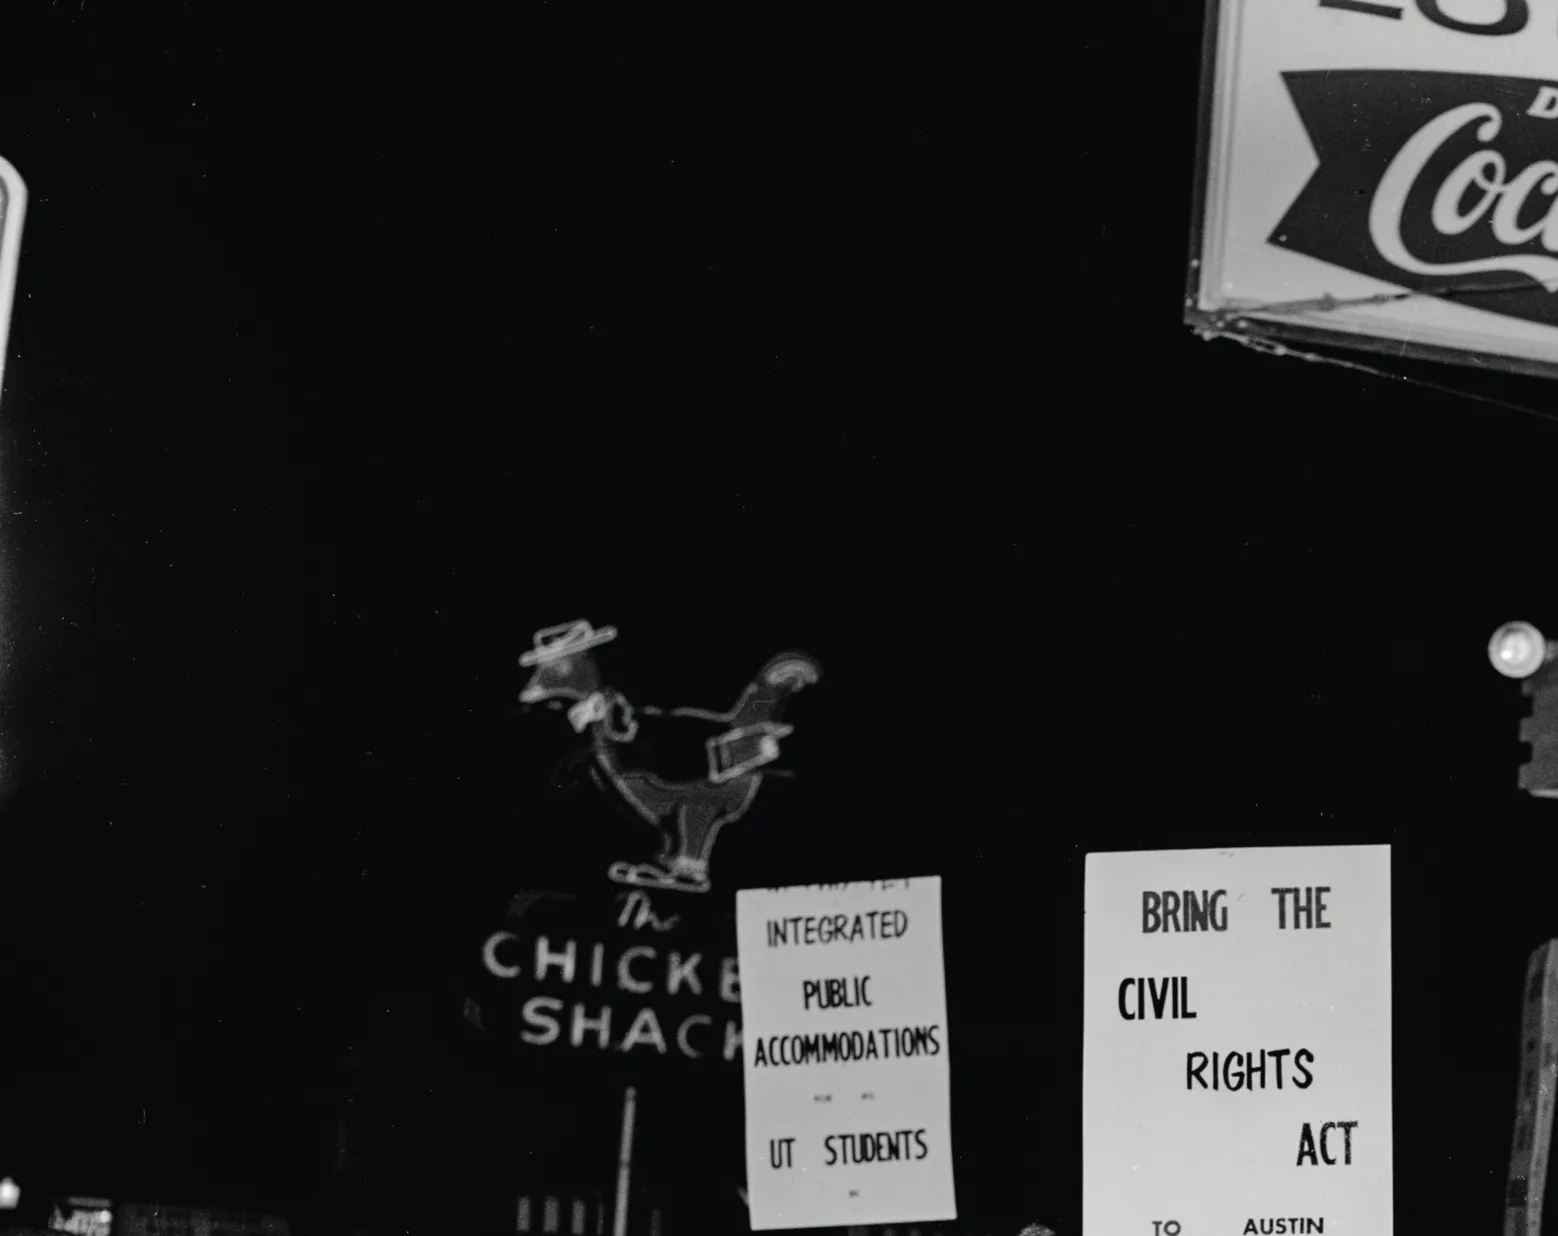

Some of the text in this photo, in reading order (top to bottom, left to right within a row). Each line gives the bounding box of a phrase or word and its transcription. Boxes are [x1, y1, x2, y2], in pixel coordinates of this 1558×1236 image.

[616, 888, 682, 931] The
[766, 908, 909, 949] INTEGRATED
[1141, 886, 1332, 934] BRING THE
[481, 930, 741, 1004] CHICKE
[802, 975, 873, 1011] PUBLIC
[1117, 975, 1198, 1021] CIVIL
[753, 1024, 941, 1068] ACCOMMODATIONS
[1186, 1047, 1315, 1092] RIGHTS
[769, 1128, 929, 1170] UT STUDENTS
[1295, 1120, 1359, 1167] ACT
[1242, 1216, 1325, 1236] AUSTIN
